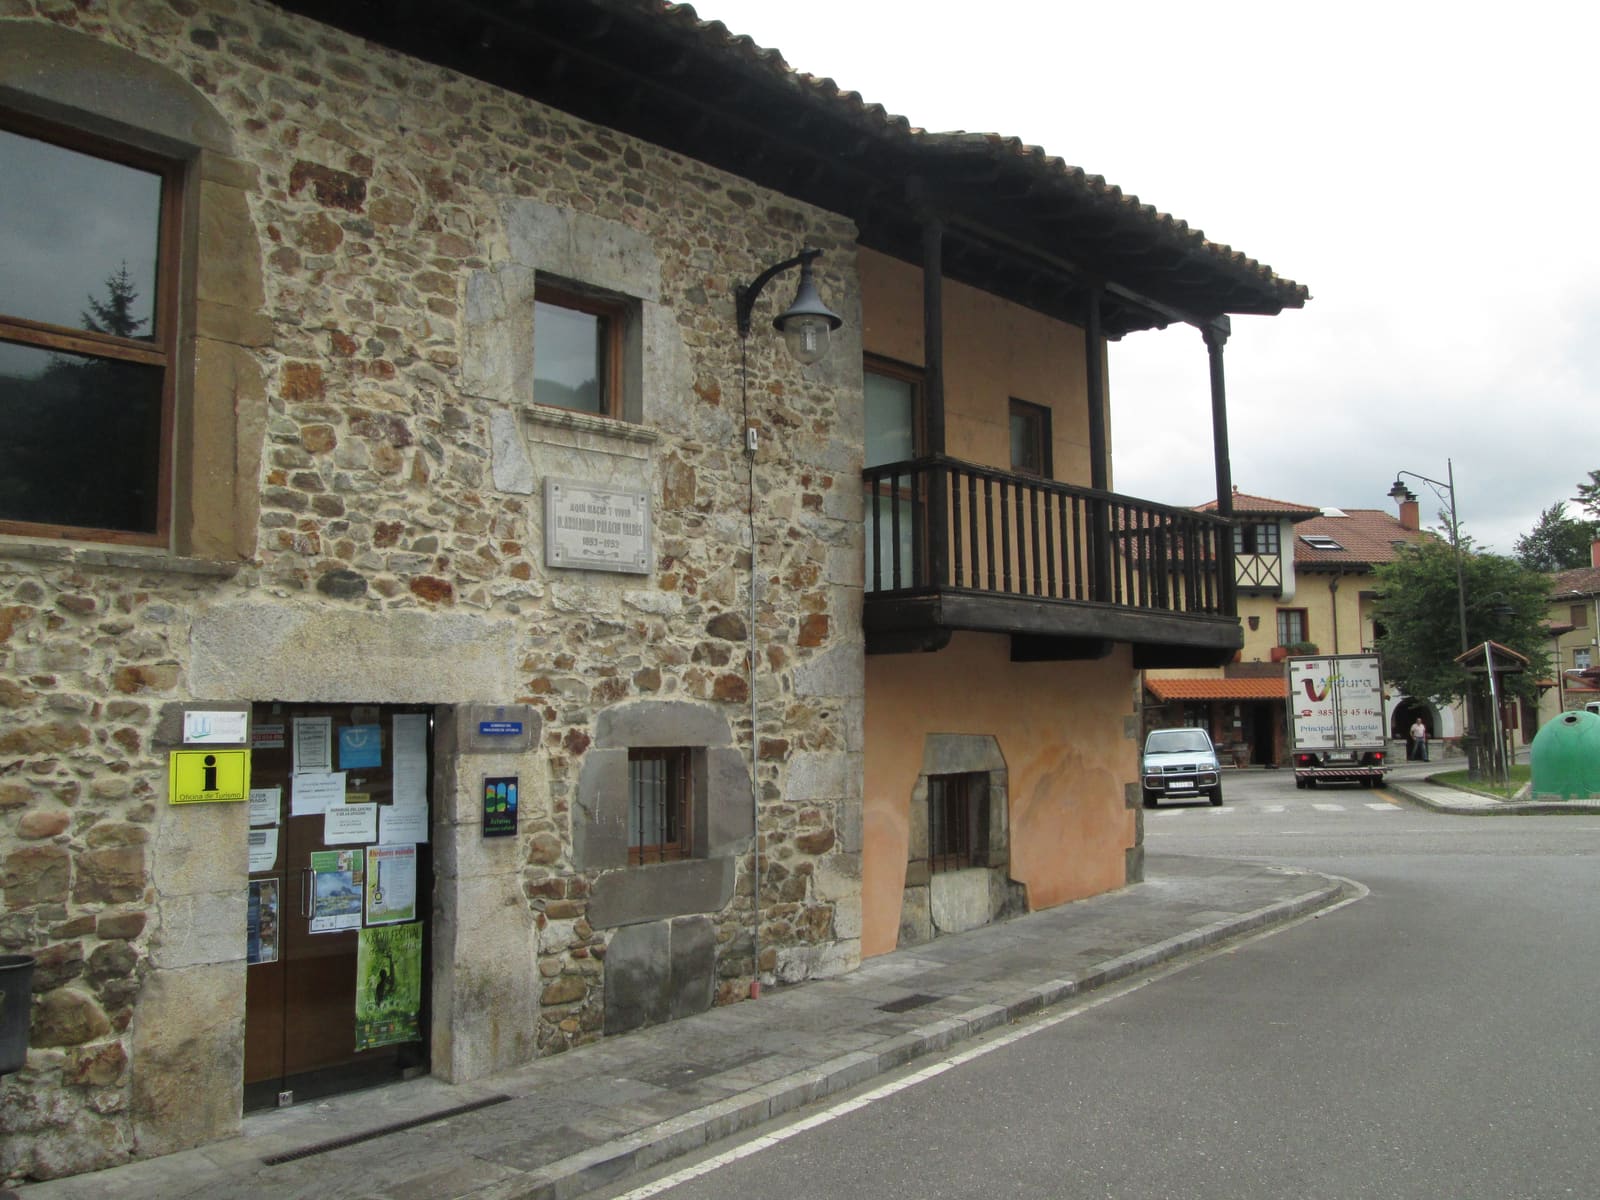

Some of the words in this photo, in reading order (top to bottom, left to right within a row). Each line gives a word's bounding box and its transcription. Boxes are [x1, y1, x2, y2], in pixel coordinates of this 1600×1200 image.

[1300, 724, 1337, 734] Principad
[179, 792, 204, 801] Oficina
[214, 791, 242, 800] Turismo
